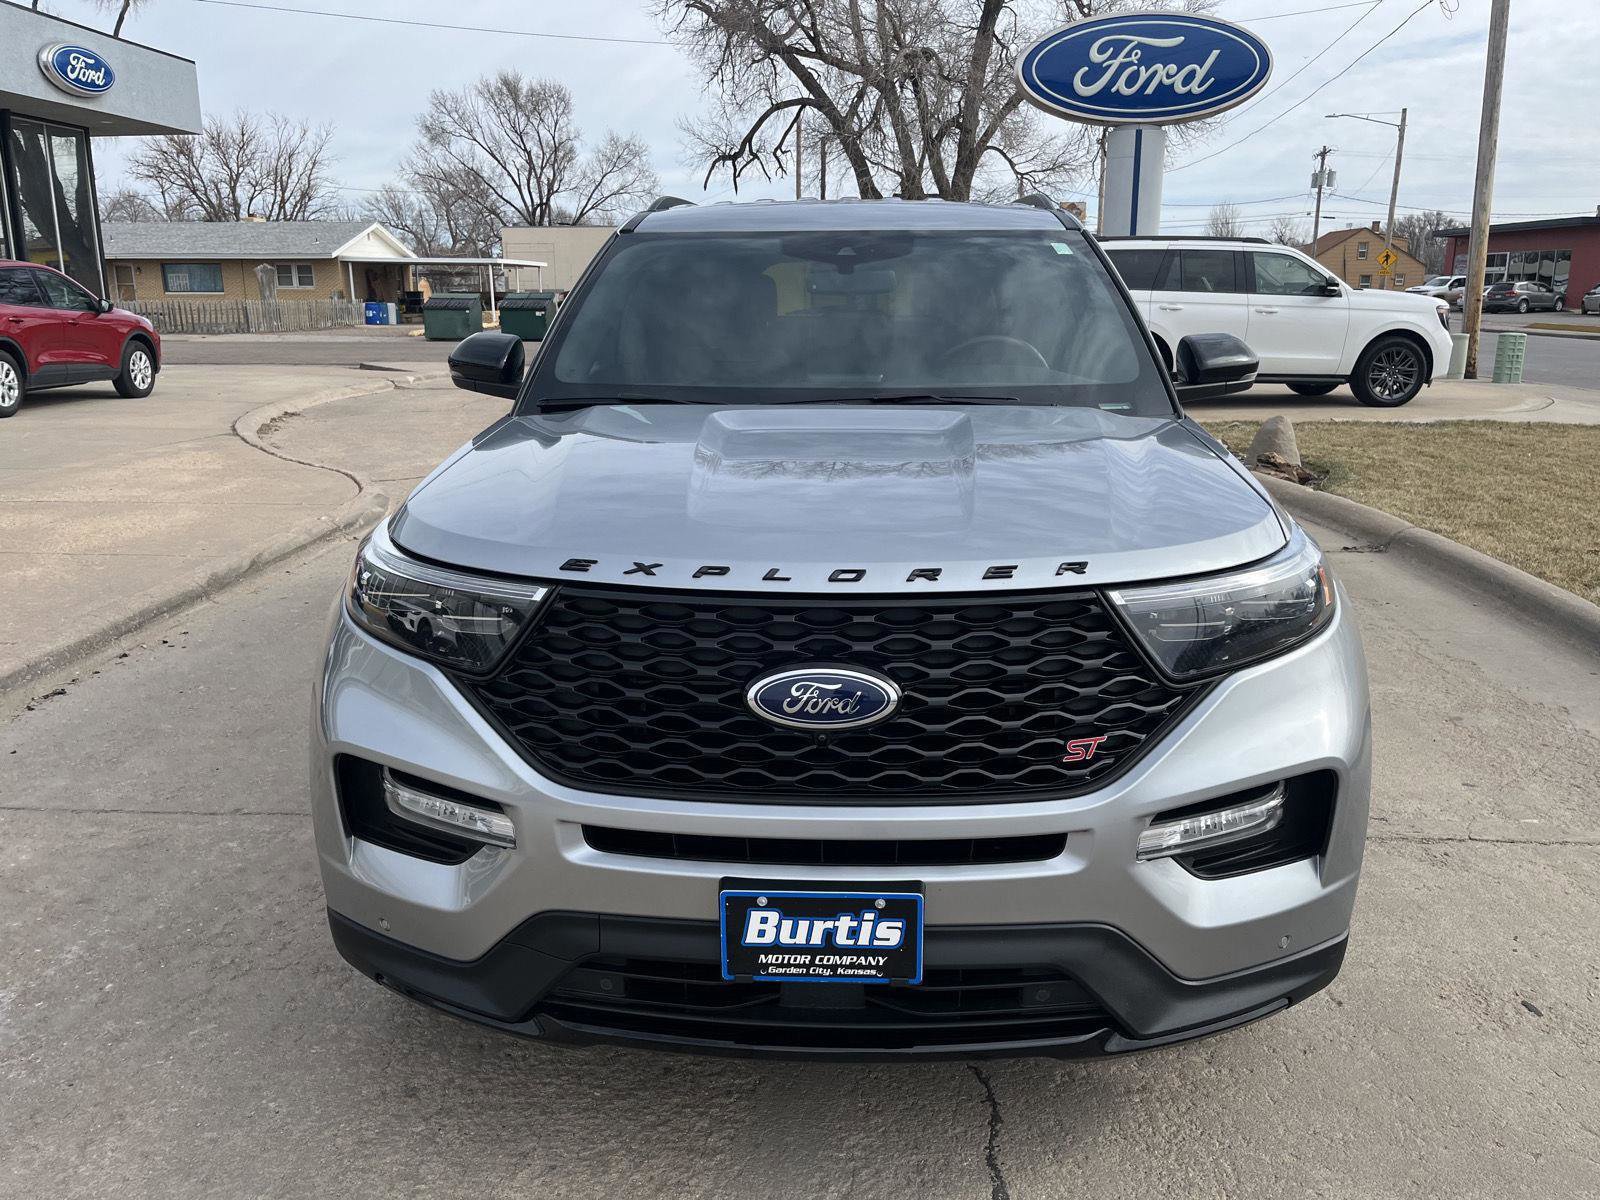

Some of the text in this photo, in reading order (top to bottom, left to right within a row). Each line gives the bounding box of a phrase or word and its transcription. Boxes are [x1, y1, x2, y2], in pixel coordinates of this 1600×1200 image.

[66, 52, 106, 86] Ford
[1072, 34, 1222, 97] Ford
[558, 557, 1091, 583] EXPLORER
[782, 681, 863, 714] Ford
[1062, 735, 1108, 762] ST
[743, 909, 904, 947] Burtis
[758, 954, 888, 966] MOTOR COMPANY
[767, 965, 807, 975] Garden
